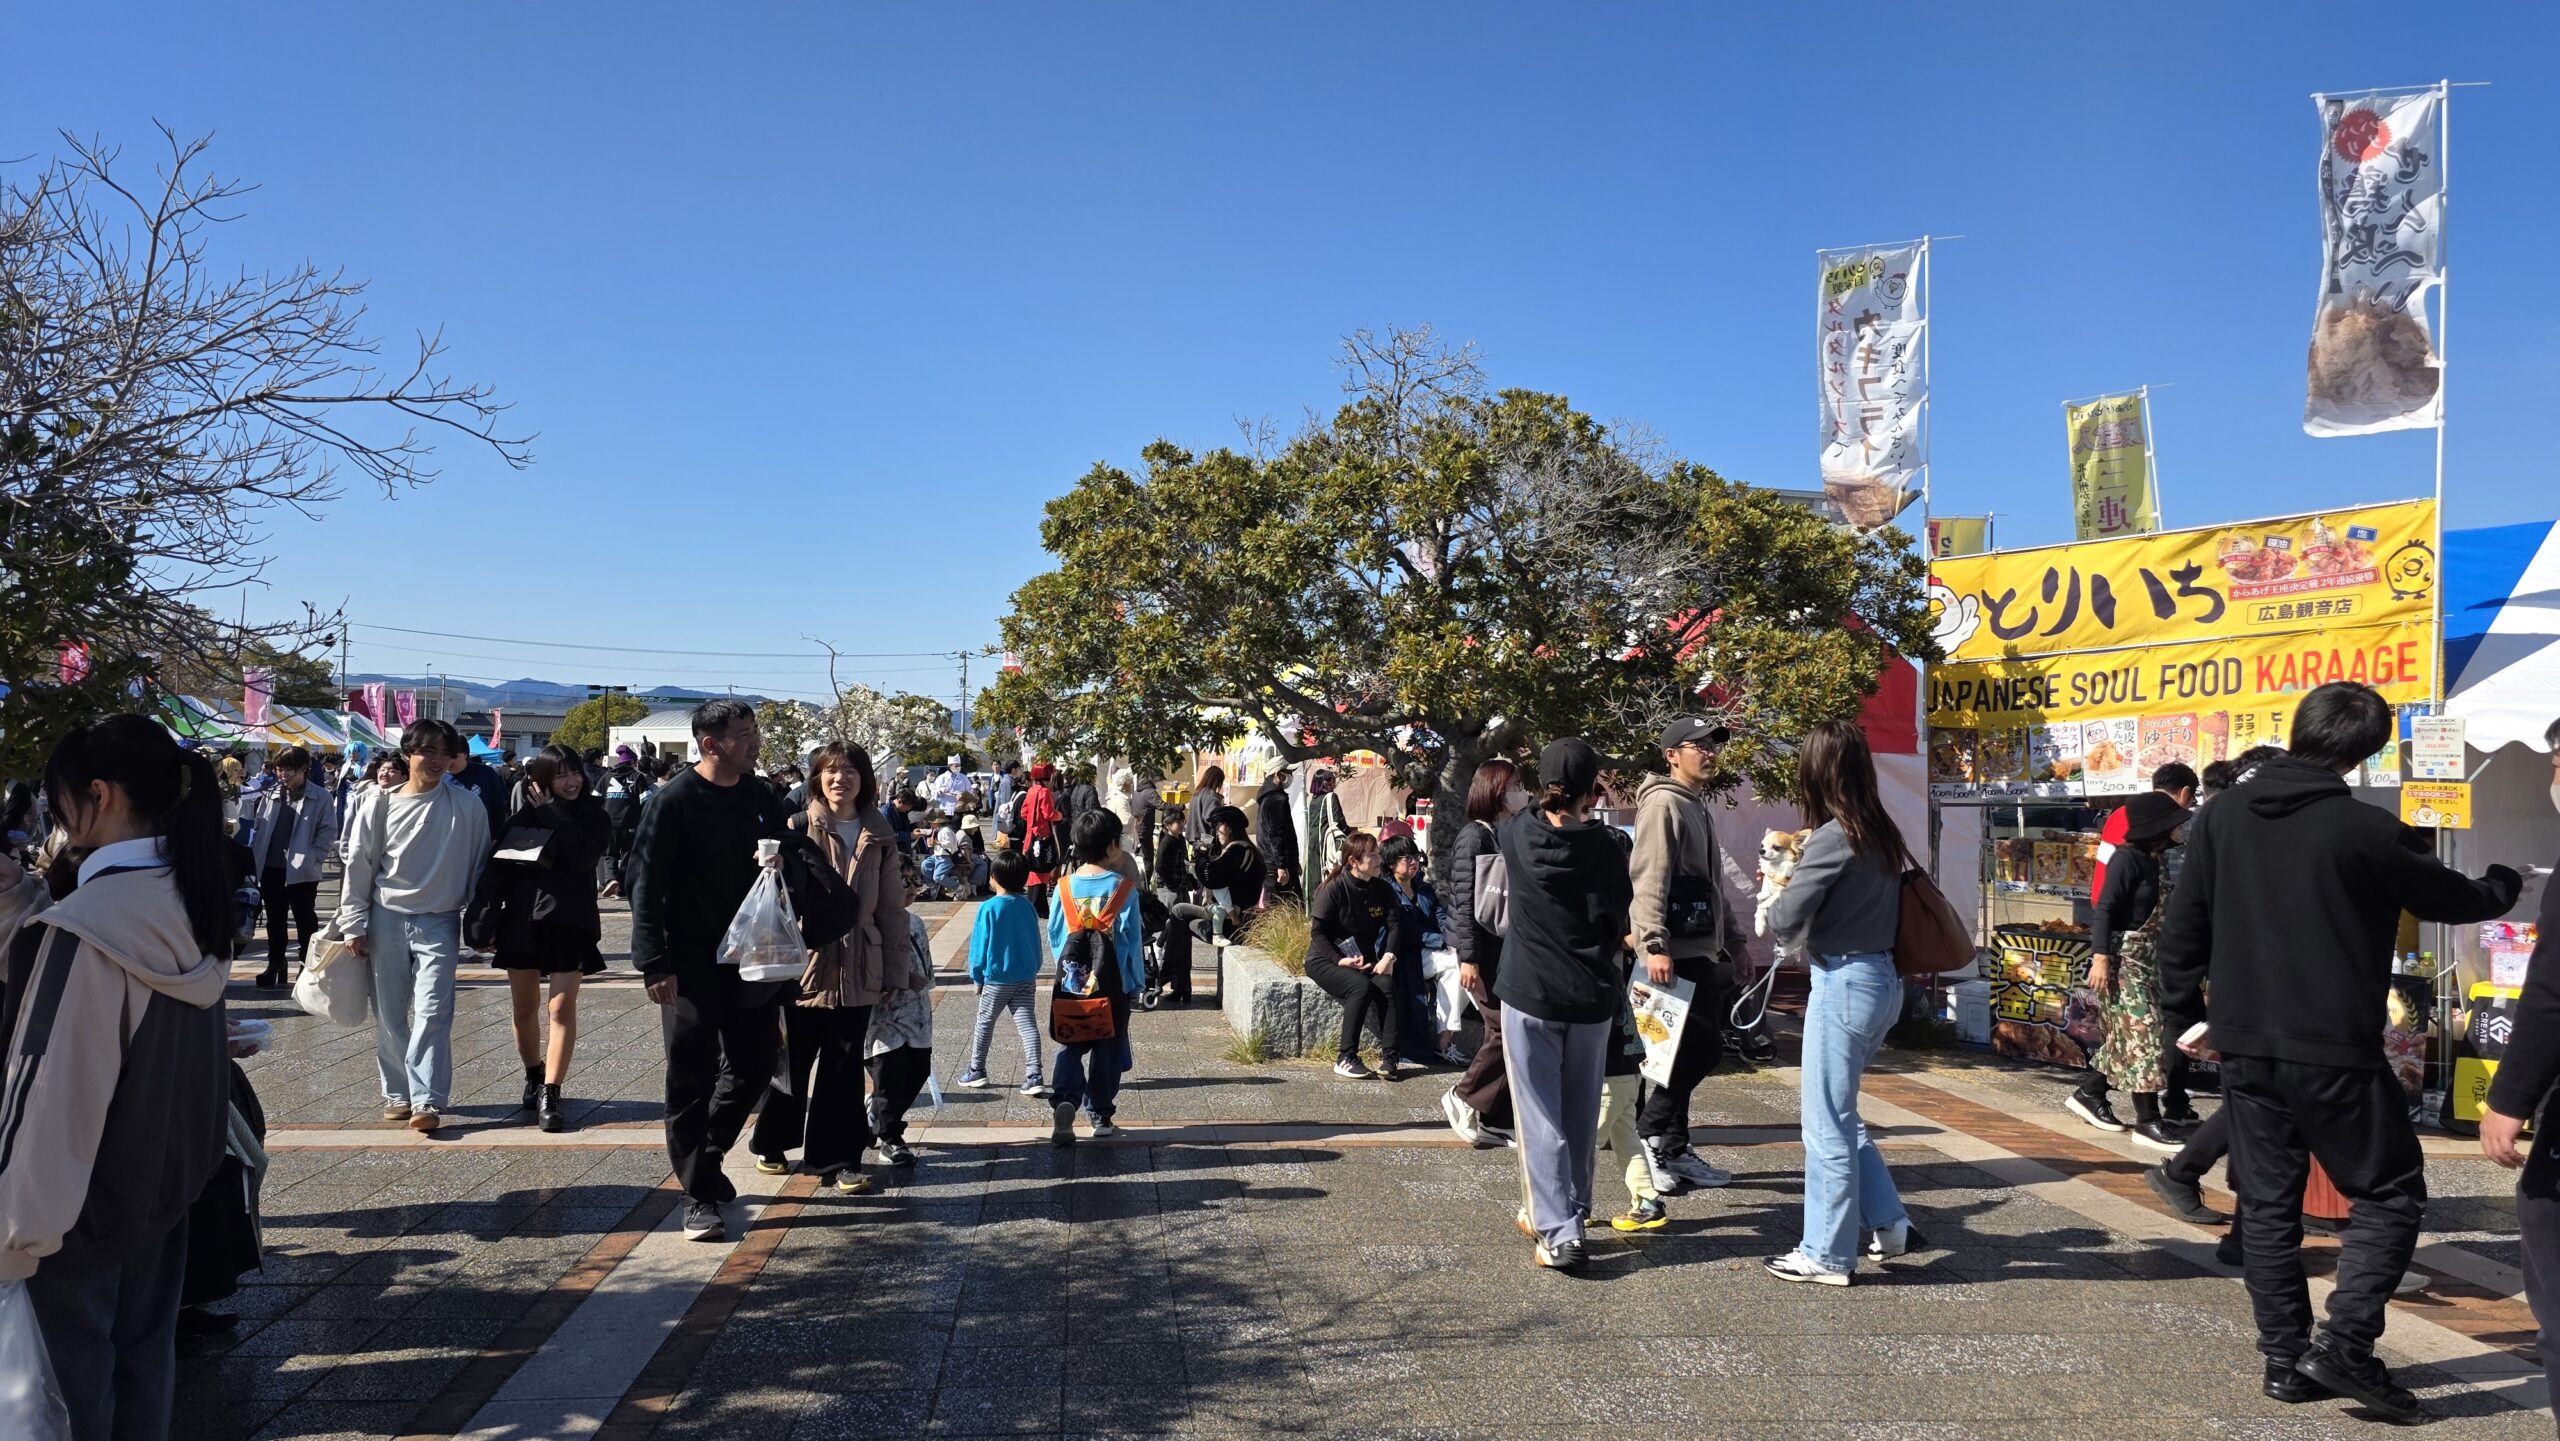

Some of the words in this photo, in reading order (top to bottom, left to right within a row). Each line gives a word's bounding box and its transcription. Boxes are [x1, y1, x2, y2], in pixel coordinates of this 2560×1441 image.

[1981, 559, 2225, 640] とりいち
[2257, 598, 2353, 622] 広島観音店
[1927, 674, 2061, 714] JAPANESE
[2070, 667, 2147, 707] SOUL
[2159, 657, 2242, 699] FOOD
[2256, 641, 2418, 693] KARAAGE
[2144, 728, 2192, 745] 砂ずり
[2270, 711, 2282, 744] ビール
[2033, 744, 2078, 755] カキフライ
[1999, 948, 2074, 988] 最高
[1998, 983, 2074, 1030] 金賞
[2479, 1011, 2487, 1044] CREATE
